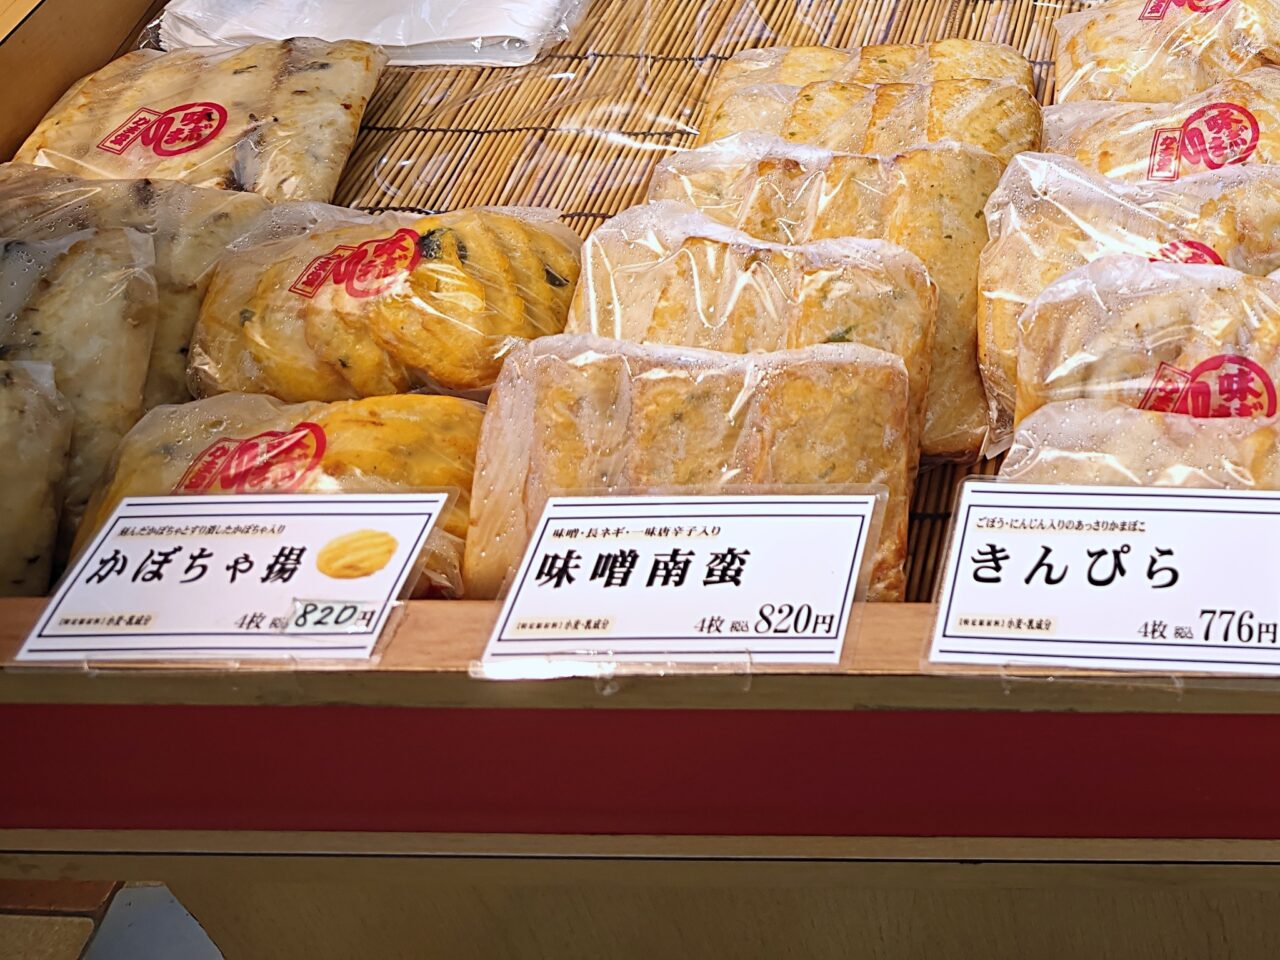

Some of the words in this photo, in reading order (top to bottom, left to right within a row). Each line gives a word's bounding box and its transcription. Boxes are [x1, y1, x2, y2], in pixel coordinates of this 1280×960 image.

[86, 546, 306, 584] かぼちゃ揚
[535, 547, 752, 589] 味噌南蛮
[971, 543, 1180, 589] きんぴら
[755, 603, 834, 636] 820円
[1199, 609, 1278, 644] 776円
